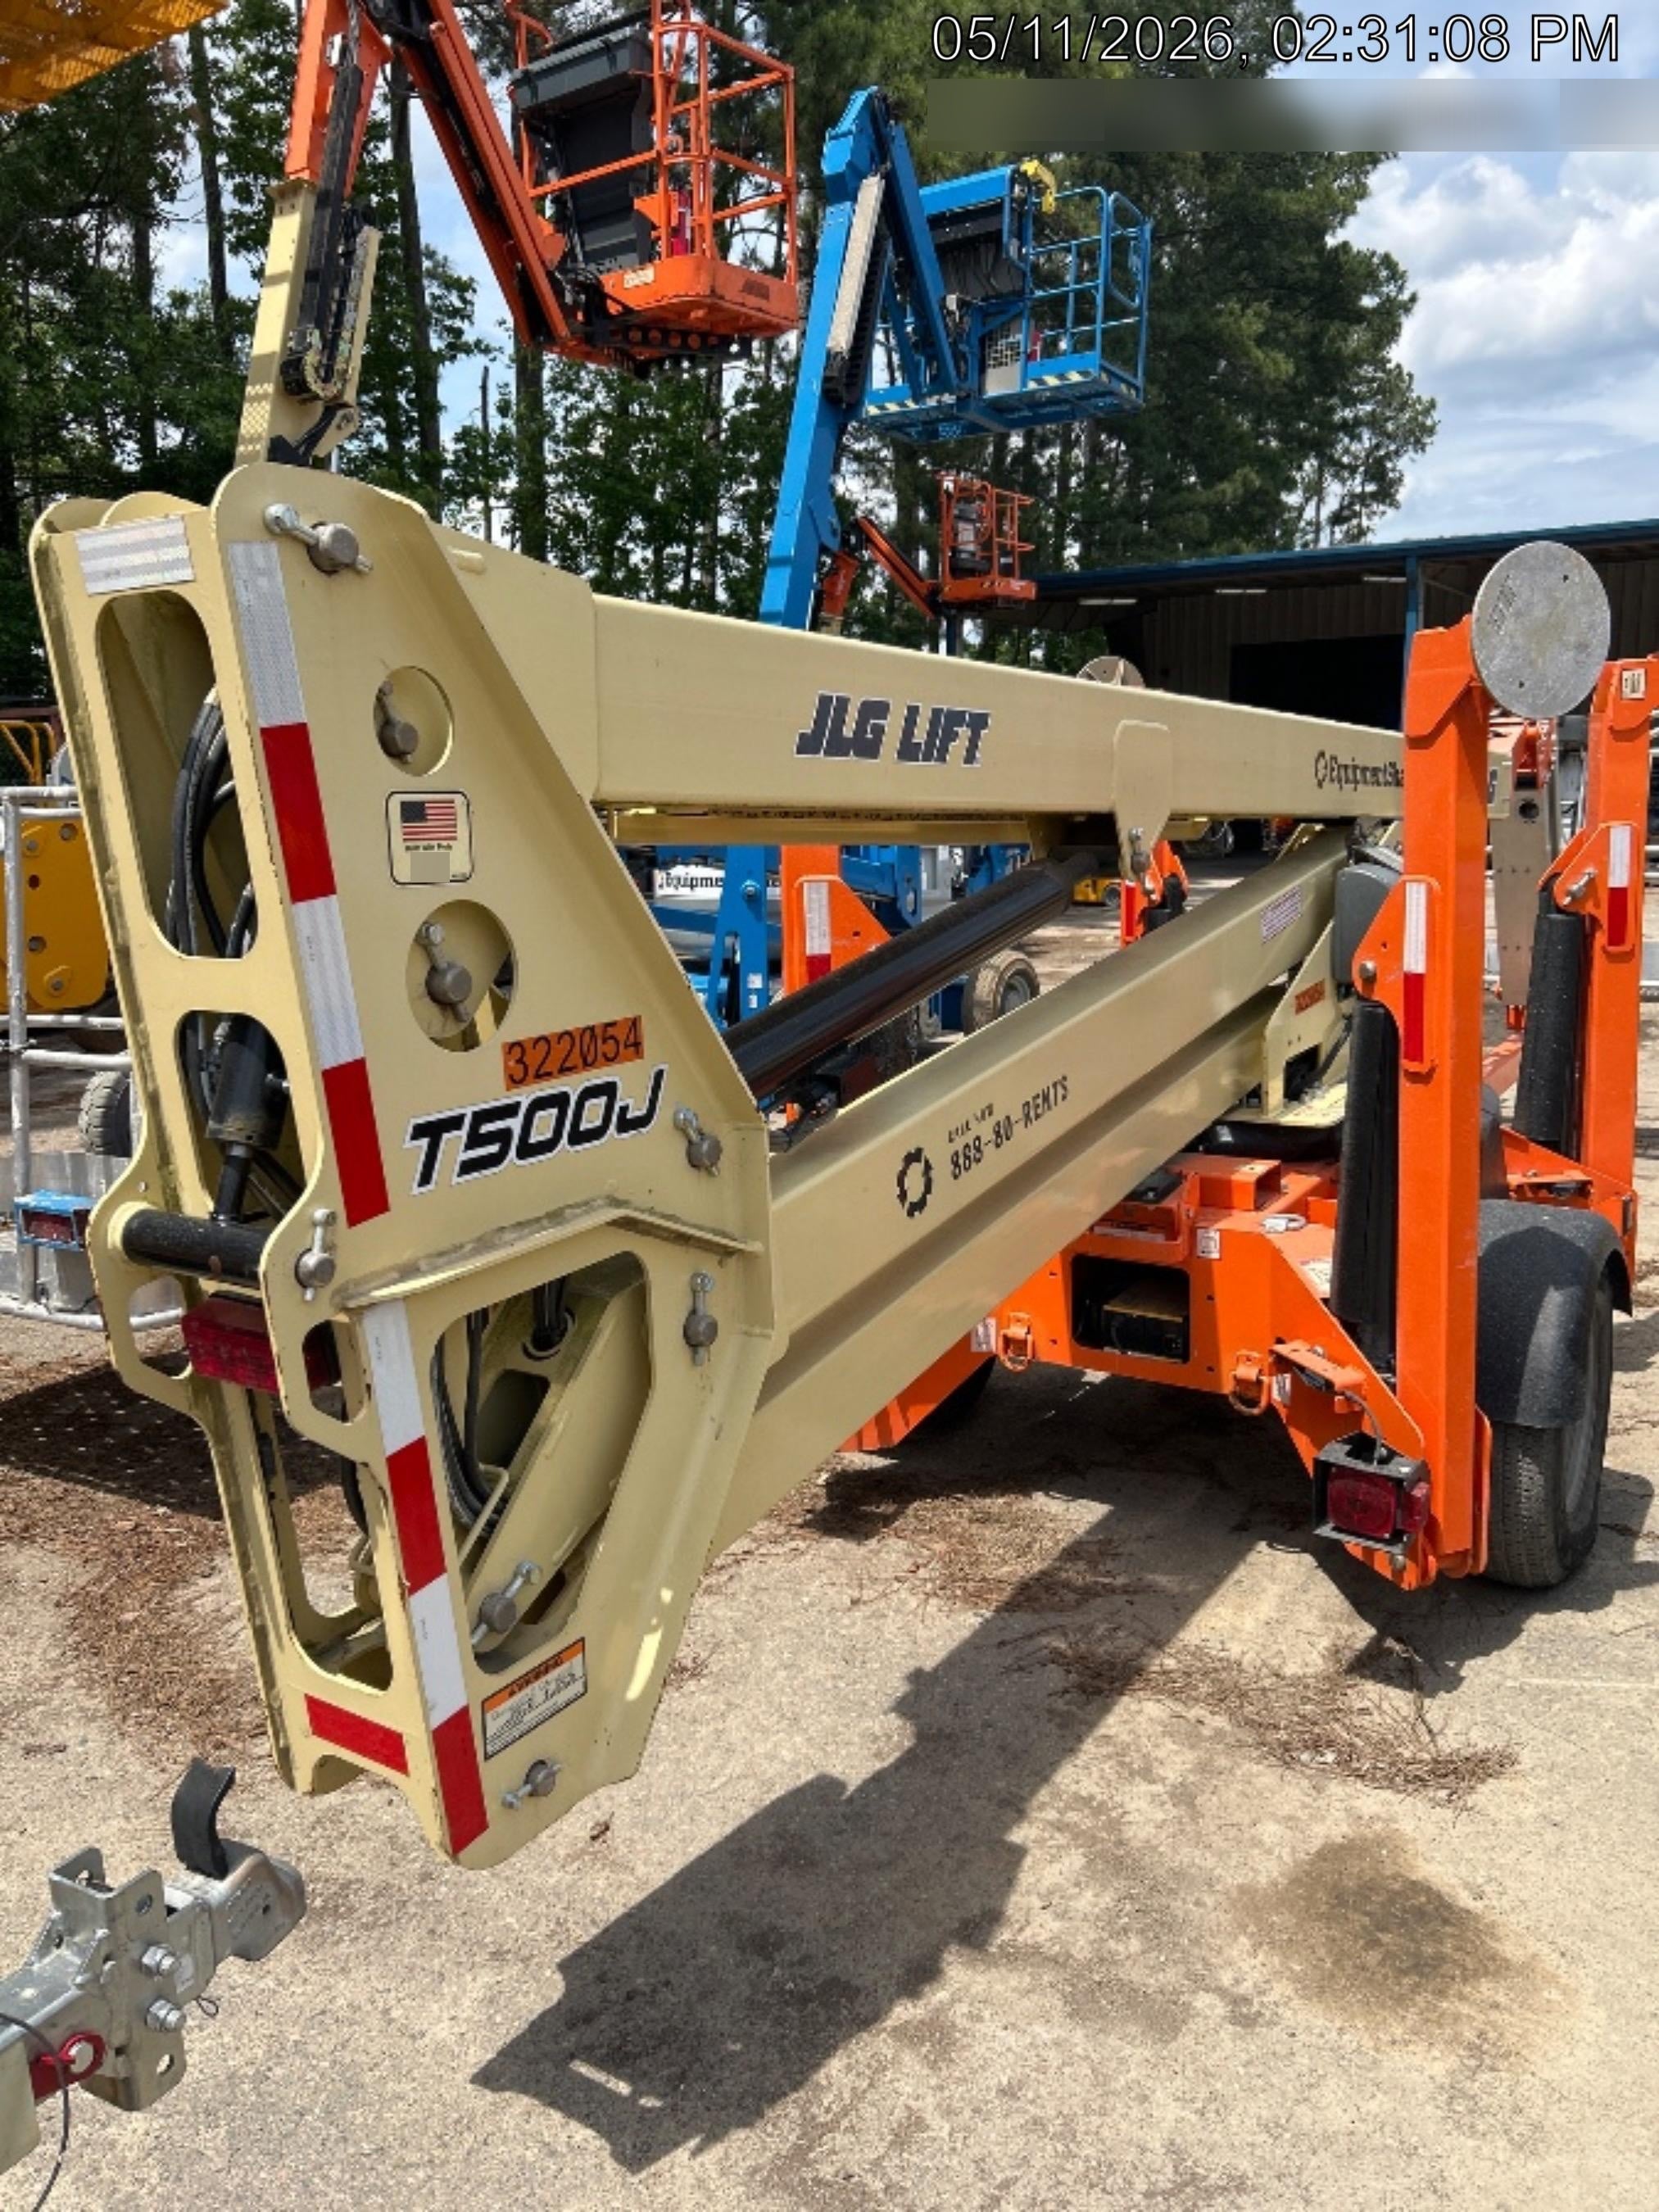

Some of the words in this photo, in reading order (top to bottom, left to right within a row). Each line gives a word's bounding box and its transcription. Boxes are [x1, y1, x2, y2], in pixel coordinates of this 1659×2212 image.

[794, 691, 891, 762] JLG
[895, 702, 990, 768] LIFT
[506, 1018, 642, 1085] 322054
[402, 1063, 669, 1195] T500J
